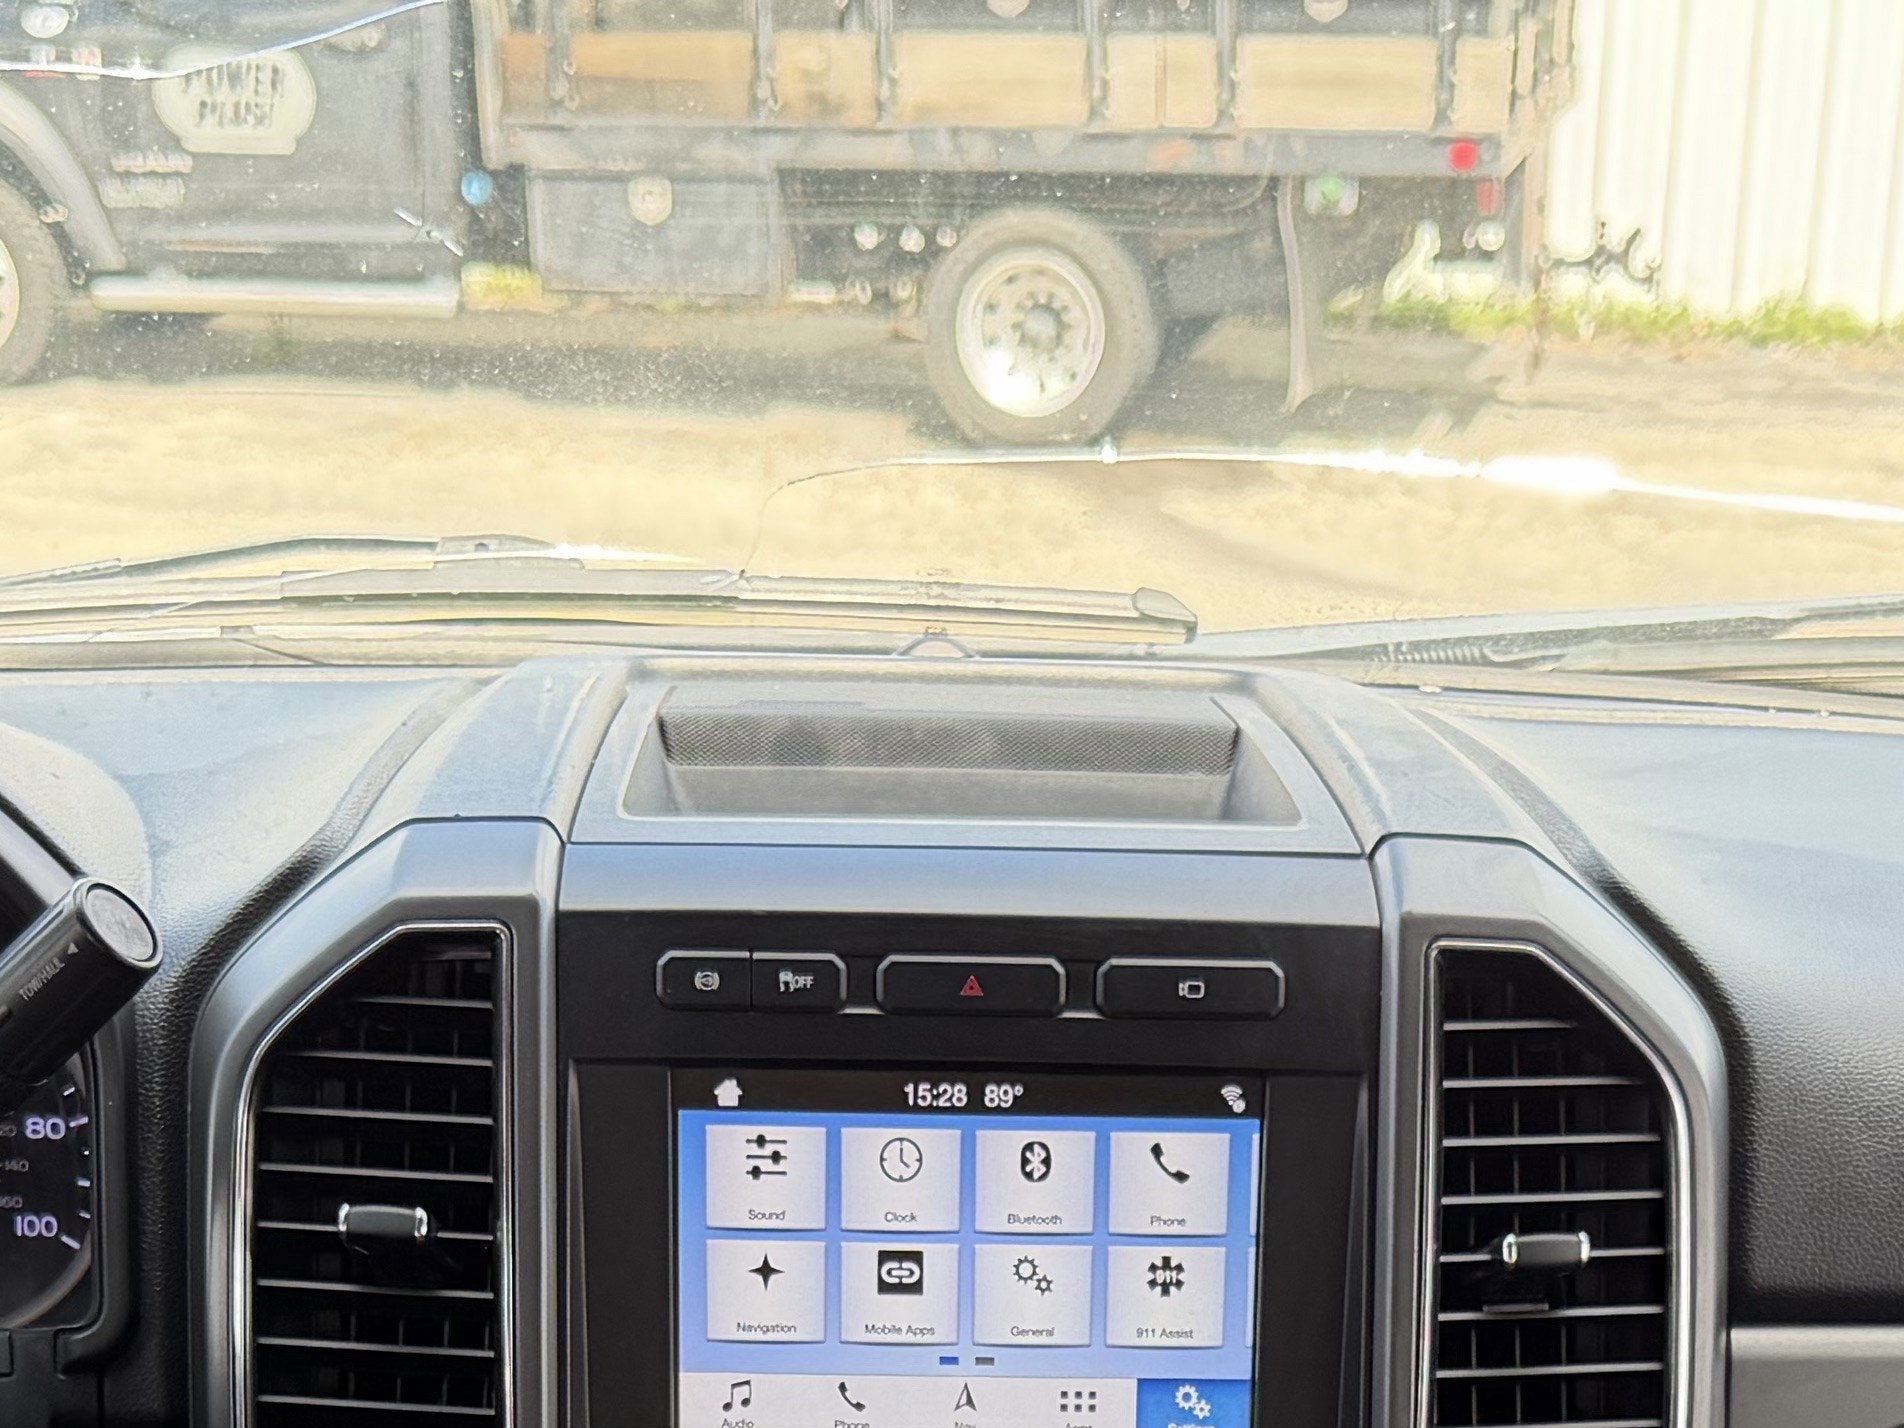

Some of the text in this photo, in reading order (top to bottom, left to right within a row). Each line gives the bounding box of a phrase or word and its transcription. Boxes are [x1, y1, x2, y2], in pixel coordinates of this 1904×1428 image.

[794, 974, 814, 989] OFF
[904, 1084, 1023, 1107] 15:28 89°
[24, 1116, 65, 1139] 80
[748, 1208, 786, 1222] Sound
[884, 1210, 917, 1224] Clock
[1007, 1212, 1063, 1226] Bluetooth
[1151, 1214, 1186, 1228] Phone
[14, 1215, 57, 1238] 100
[1155, 1268, 1178, 1284] 911
[736, 1320, 797, 1336] Navigation
[865, 1323, 935, 1339] Mobile Apps
[1011, 1325, 1054, 1339] General
[1136, 1326, 1194, 1340] 911 Assist
